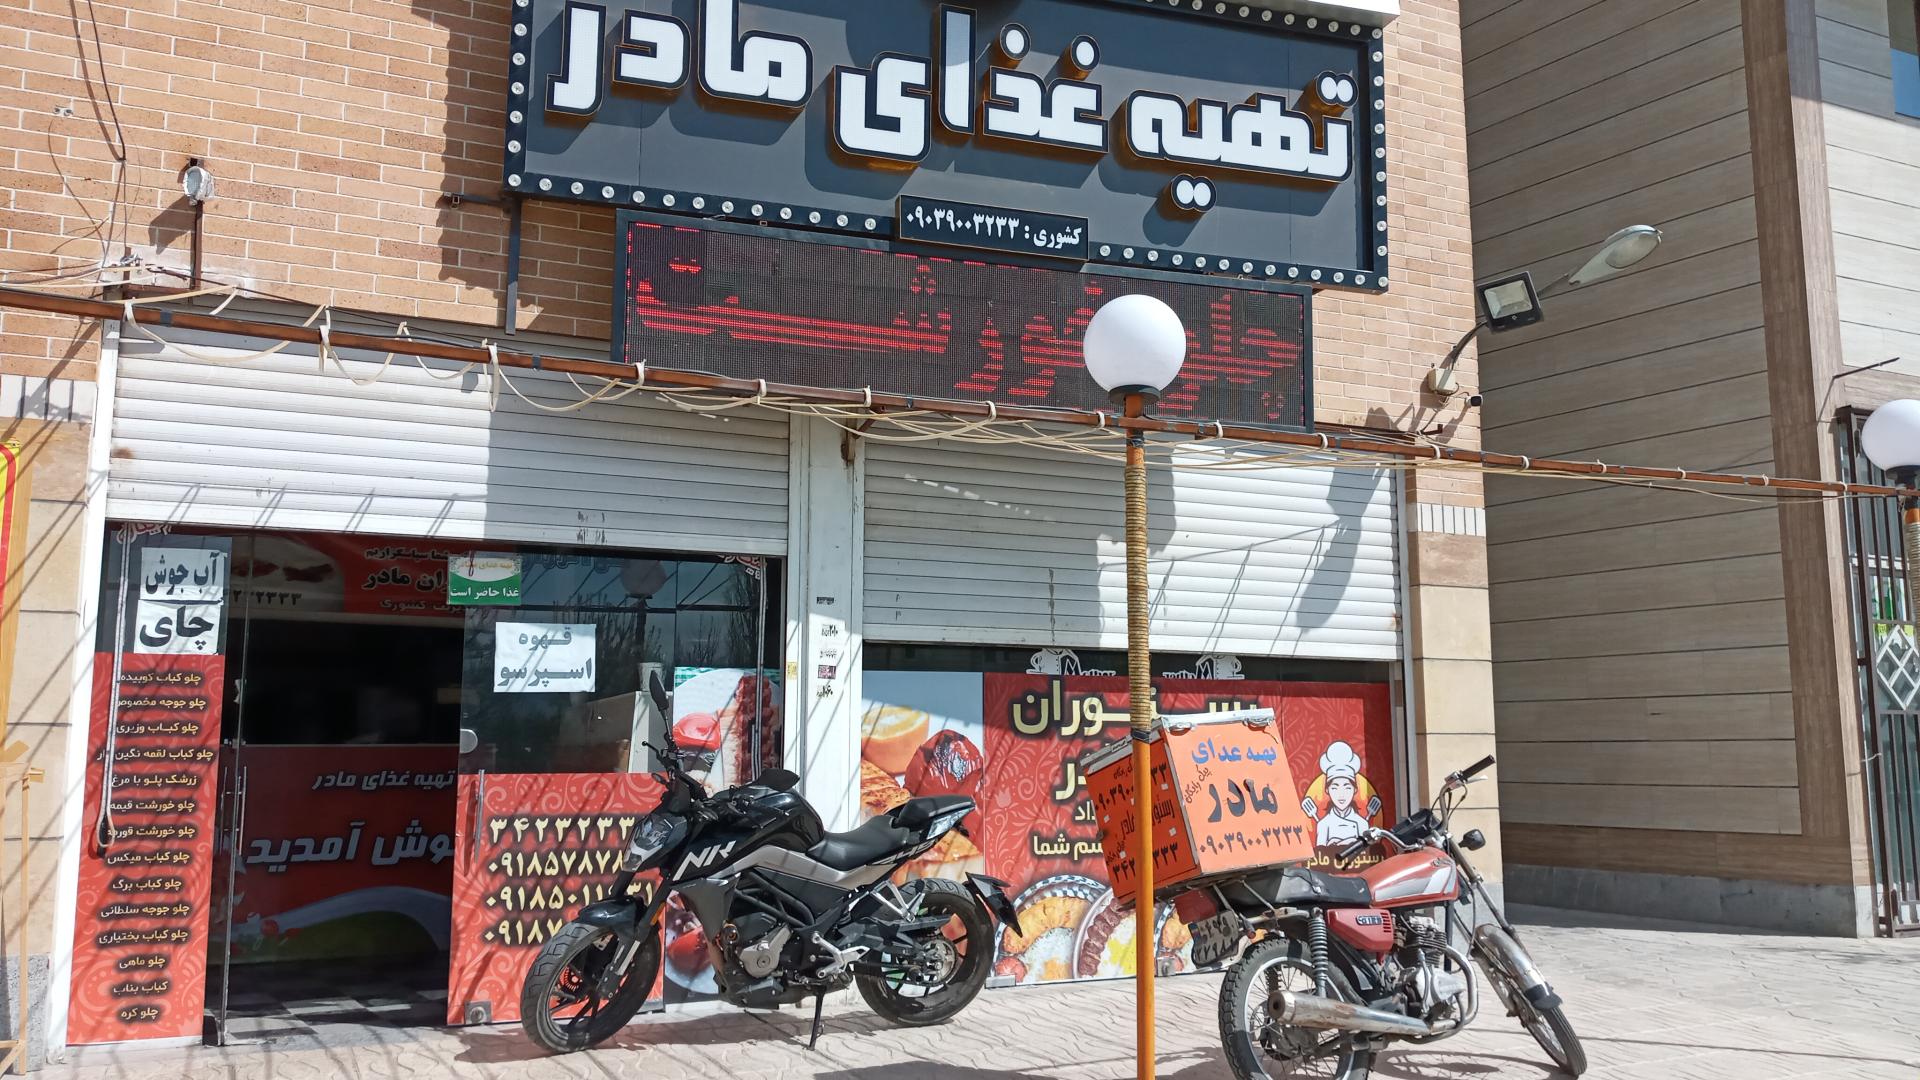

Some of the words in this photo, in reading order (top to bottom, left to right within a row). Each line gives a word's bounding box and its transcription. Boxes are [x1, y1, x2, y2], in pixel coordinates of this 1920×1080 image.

[547, 0, 810, 113] مادر
[836, 3, 1107, 161] غذای
[1128, 71, 1356, 211] تهیه
[906, 205, 1020, 240] ۰۹۰۳۹۰۰۳۲۳۳
[145, 554, 189, 595] جوش
[193, 551, 220, 594] آب
[361, 565, 411, 590] مادر
[450, 586, 471, 597] است
[474, 586, 500, 600] حاضر
[503, 586, 519, 597] غذا
[139, 605, 214, 650] چای
[518, 626, 573, 651] قهوه
[121, 673, 154, 684] کوبیده
[156, 672, 182, 684] کباب
[497, 658, 593, 688] اسپرسو
[184, 674, 202, 685] چلو
[159, 699, 187, 709] جوجه
[189, 698, 206, 709] چلو
[116, 723, 145, 733] وزیری
[147, 722, 180, 734] کباب
[181, 723, 199, 735] چلو
[114, 749, 141, 760] نگین
[143, 749, 166, 758] لقمه
[168, 749, 195, 761] کباب
[196, 749, 214, 761] چلو
[112, 774, 130, 787] مرغ
[133, 775, 141, 785] با
[144, 775, 163, 787] پلو
[165, 774, 197, 785] زرشک
[312, 771, 357, 790] مادر
[362, 770, 411, 790] غذای
[414, 770, 456, 790] تهیه
[109, 800, 133, 811] قیمه
[135, 800, 175, 812] خورشت
[178, 800, 195, 812] چلو
[1207, 777, 1279, 823] مادر
[136, 826, 175, 838] خورشت
[178, 826, 196, 838] چلو
[489, 816, 635, 844] ۳۴۲۳۲۳۳
[1033, 833, 1070, 855] شما
[1199, 824, 1303, 855] ۰۹۰۳۹۰۰۳۲۳۳
[246, 821, 365, 873] آمدید
[107, 852, 141, 864] میکس
[144, 852, 171, 863] کباب
[173, 851, 190, 863] چلو
[488, 849, 624, 877] ۰۹۱۸۵۷۸۷۸
[673, 840, 736, 881] NK
[1305, 850, 1330, 869] مادر
[112, 879, 133, 891] برگ
[135, 878, 162, 890] کباب
[164, 878, 181, 891] چلو
[486, 881, 653, 912] ۰۹۱۸۵۰۱۱۳۱
[100, 905, 139, 917] سلطانی
[142, 906, 170, 916] جوجه
[172, 904, 190, 916] چلو
[98, 931, 140, 944] بختیاری
[142, 929, 169, 941] کباب
[171, 929, 188, 941] چلو
[119, 957, 145, 969] ماهی
[148, 956, 166, 968] چلو
[113, 983, 139, 994] بناب
[141, 981, 169, 993] کباب
[121, 1007, 138, 1019] کره
[141, 1007, 159, 1019] چلو
